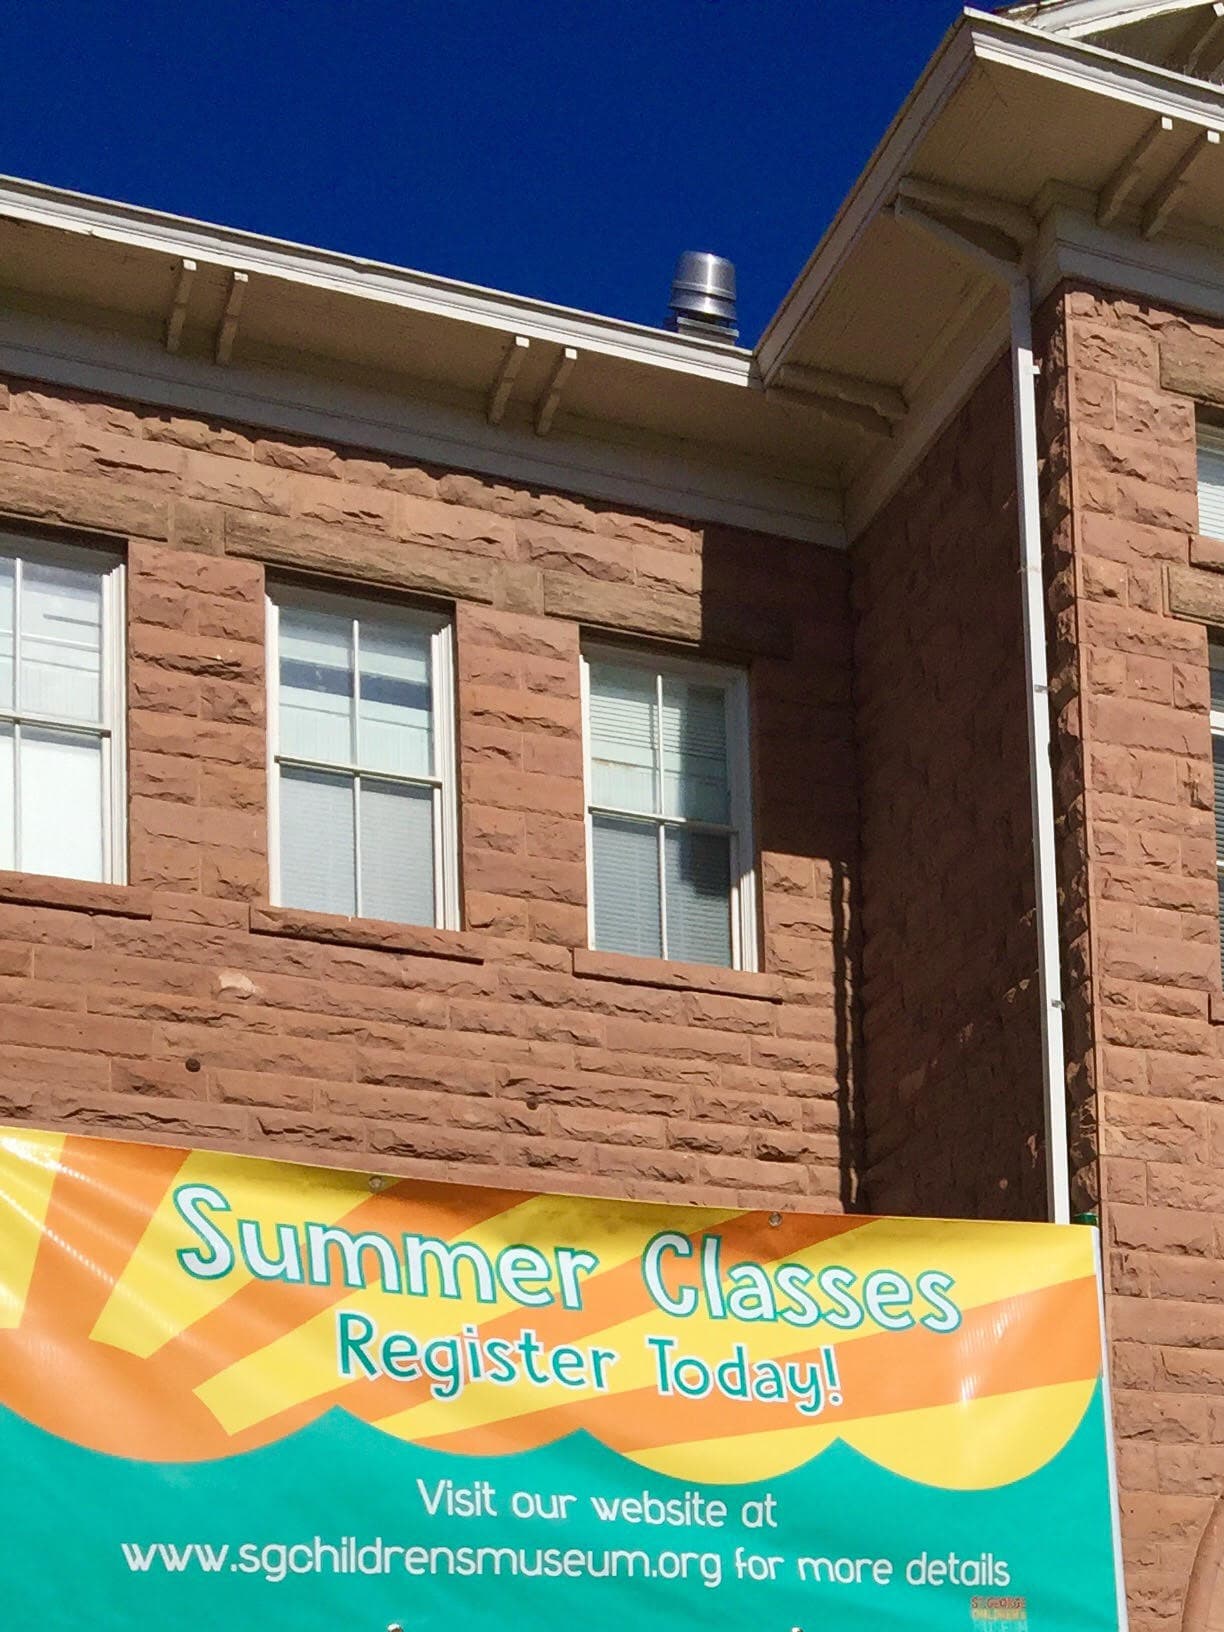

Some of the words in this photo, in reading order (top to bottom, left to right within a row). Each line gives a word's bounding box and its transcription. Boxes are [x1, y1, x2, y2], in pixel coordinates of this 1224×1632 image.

[172, 1183, 599, 1312] Summer
[641, 1228, 962, 1334] Classes
[335, 1312, 620, 1401] Register
[647, 1334, 843, 1418] Today!
[416, 1479, 498, 1520] Visit
[509, 1490, 577, 1521] our
[590, 1490, 728, 1529] website
[739, 1495, 778, 1530] at
[121, 1535, 723, 1587] www.sgchildrensmuseum.org
[734, 1546, 788, 1583] for
[798, 1557, 892, 1587] more
[904, 1550, 1012, 1588] details
